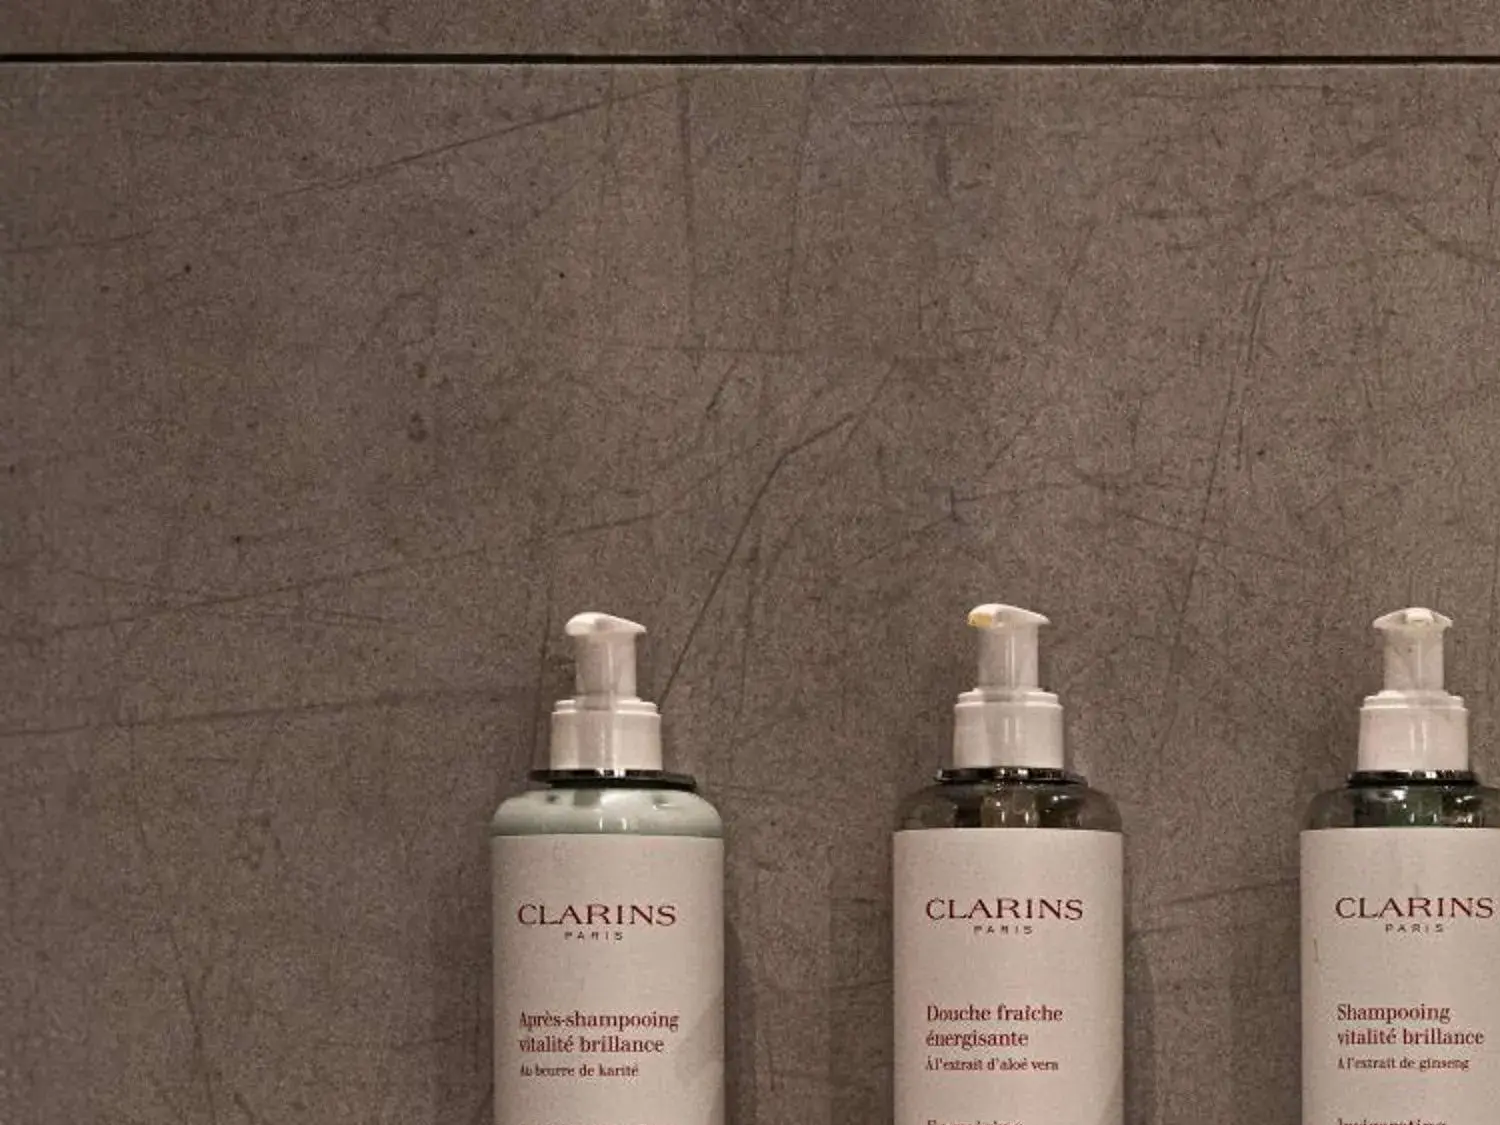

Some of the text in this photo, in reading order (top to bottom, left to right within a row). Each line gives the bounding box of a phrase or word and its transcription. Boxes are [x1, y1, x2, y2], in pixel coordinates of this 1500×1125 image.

[518, 904, 677, 926] CLARINS
[926, 898, 1084, 921] CLARINS
[1335, 897, 1494, 918] CLARINS
[565, 932, 624, 940] PARIS
[973, 926, 1033, 934] PARIS
[1385, 924, 1444, 933] PARIS
[520, 1010, 680, 1032] Après-shampooing
[927, 1003, 991, 1022] Douche
[1337, 1004, 1451, 1024] Shampooing
[519, 1036, 665, 1053] vitalité brillance
[926, 1030, 1028, 1051] énergisante
[1338, 1028, 1485, 1045] vitalité brillance
[535, 1063, 574, 1077] beurre
[579, 1063, 594, 1077] de
[599, 1063, 639, 1077] karité
[1031, 1061, 1058, 1071] vera
[1399, 1057, 1414, 1069] de
[1419, 1057, 1469, 1072] ginseng
